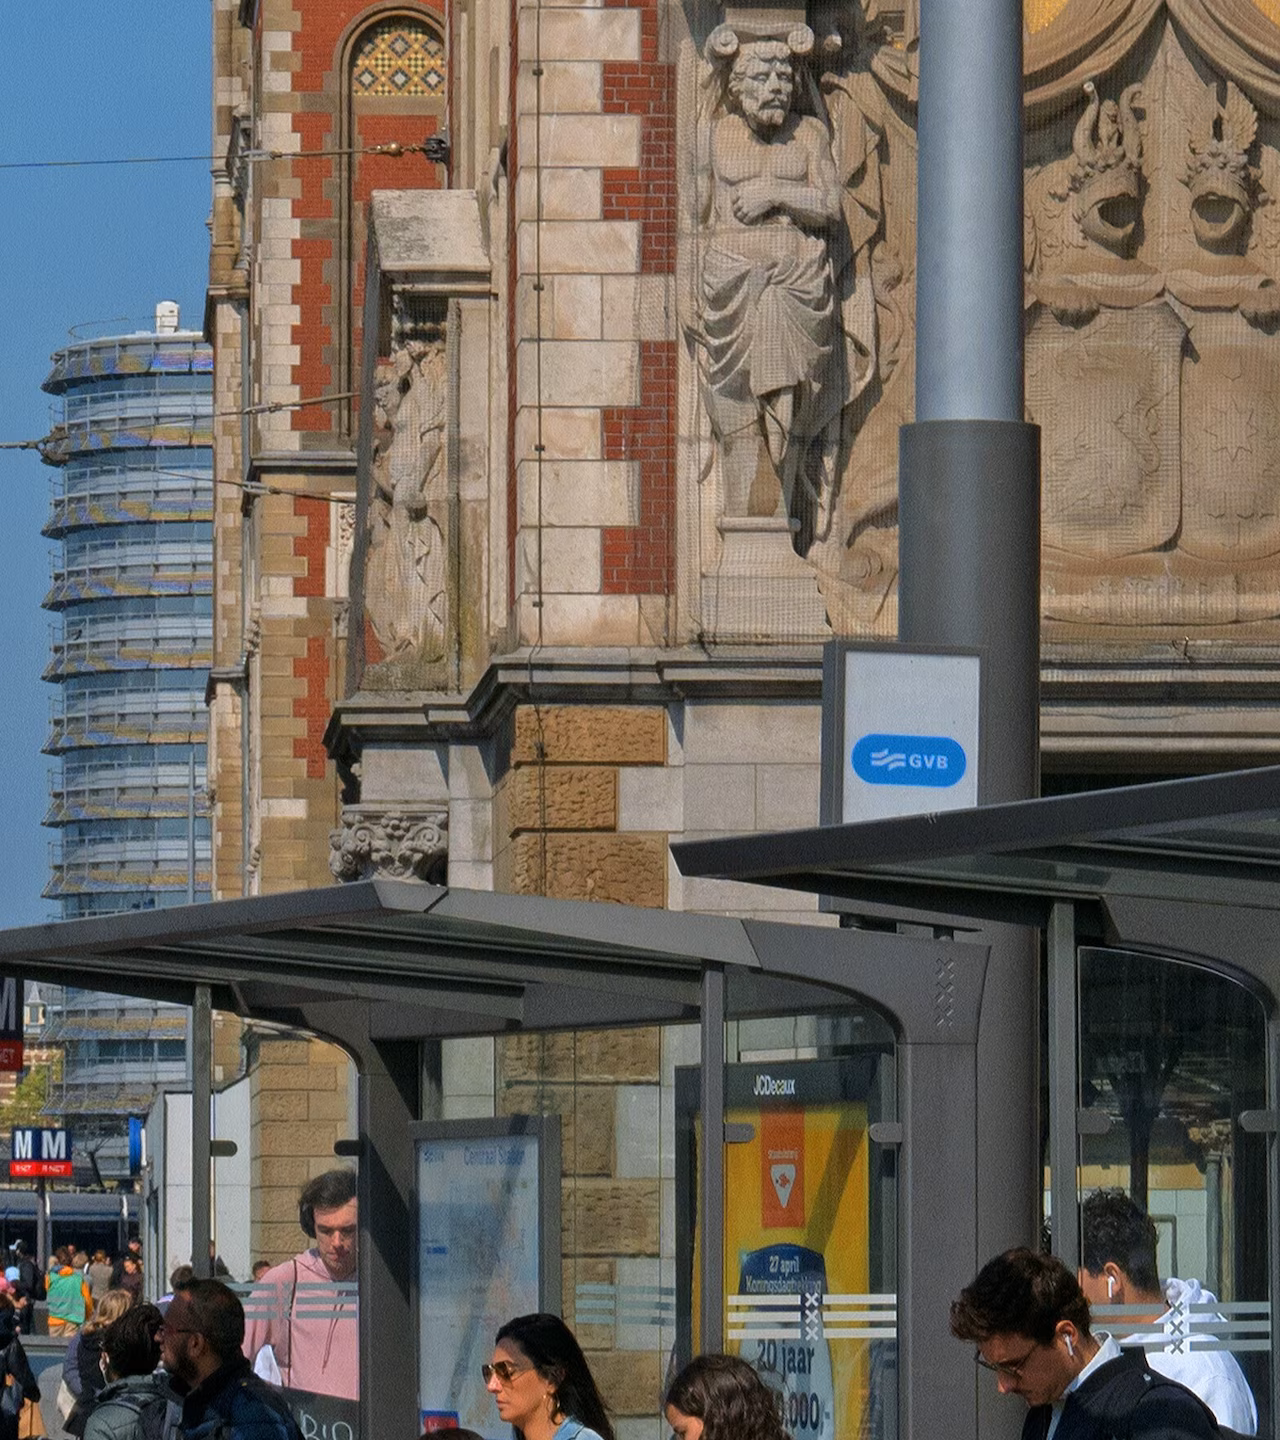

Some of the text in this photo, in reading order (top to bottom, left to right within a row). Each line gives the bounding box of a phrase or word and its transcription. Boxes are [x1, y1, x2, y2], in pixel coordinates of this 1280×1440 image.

[909, 753, 949, 770] GVB
[753, 1075, 796, 1096] JCDecaux
[15, 1131, 32, 1159] M
[42, 1131, 66, 1159] M
[769, 1255, 800, 1277] 27 april
[757, 1339, 815, 1383] 20 jaar
